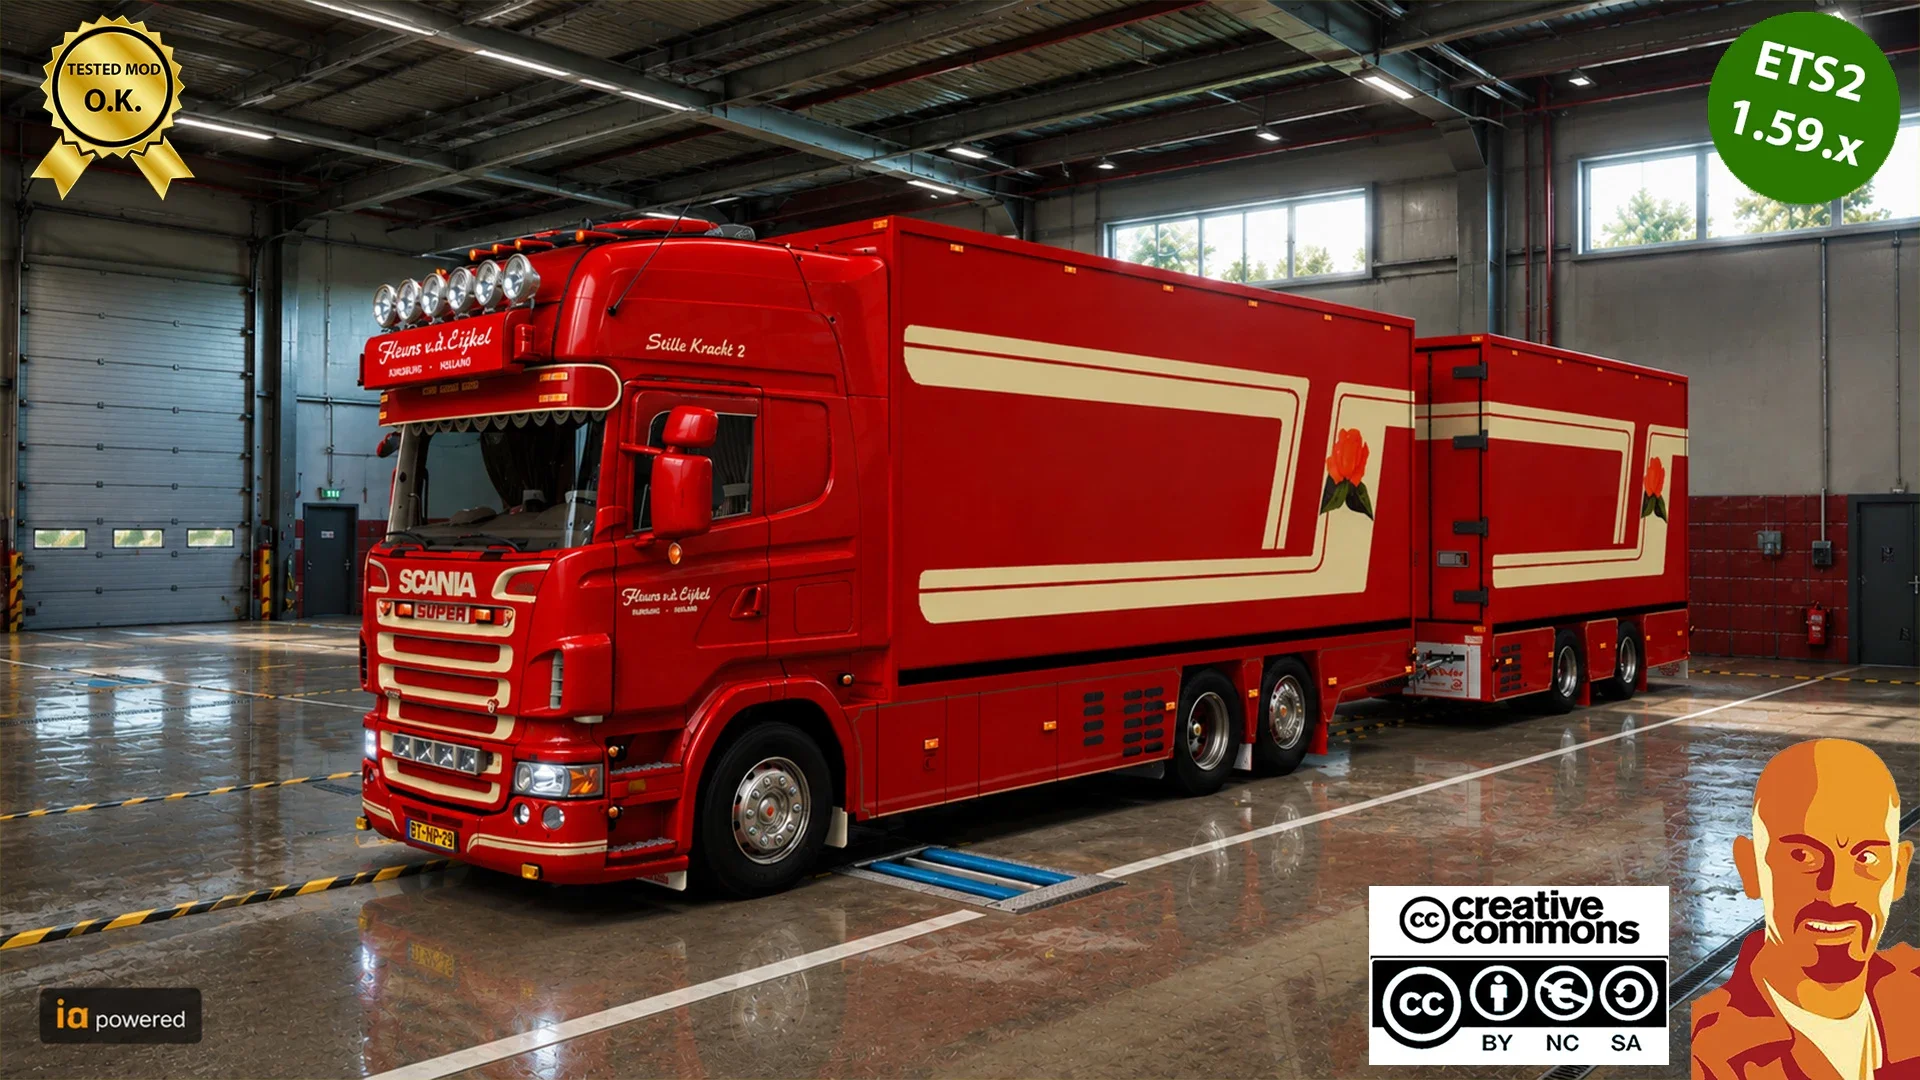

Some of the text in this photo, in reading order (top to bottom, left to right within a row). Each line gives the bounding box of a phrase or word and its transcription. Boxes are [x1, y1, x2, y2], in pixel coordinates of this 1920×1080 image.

[645, 333, 687, 353] Stille
[737, 344, 746, 358] 2
[398, 568, 477, 598] SCANIA
[416, 603, 467, 622] SUPER
